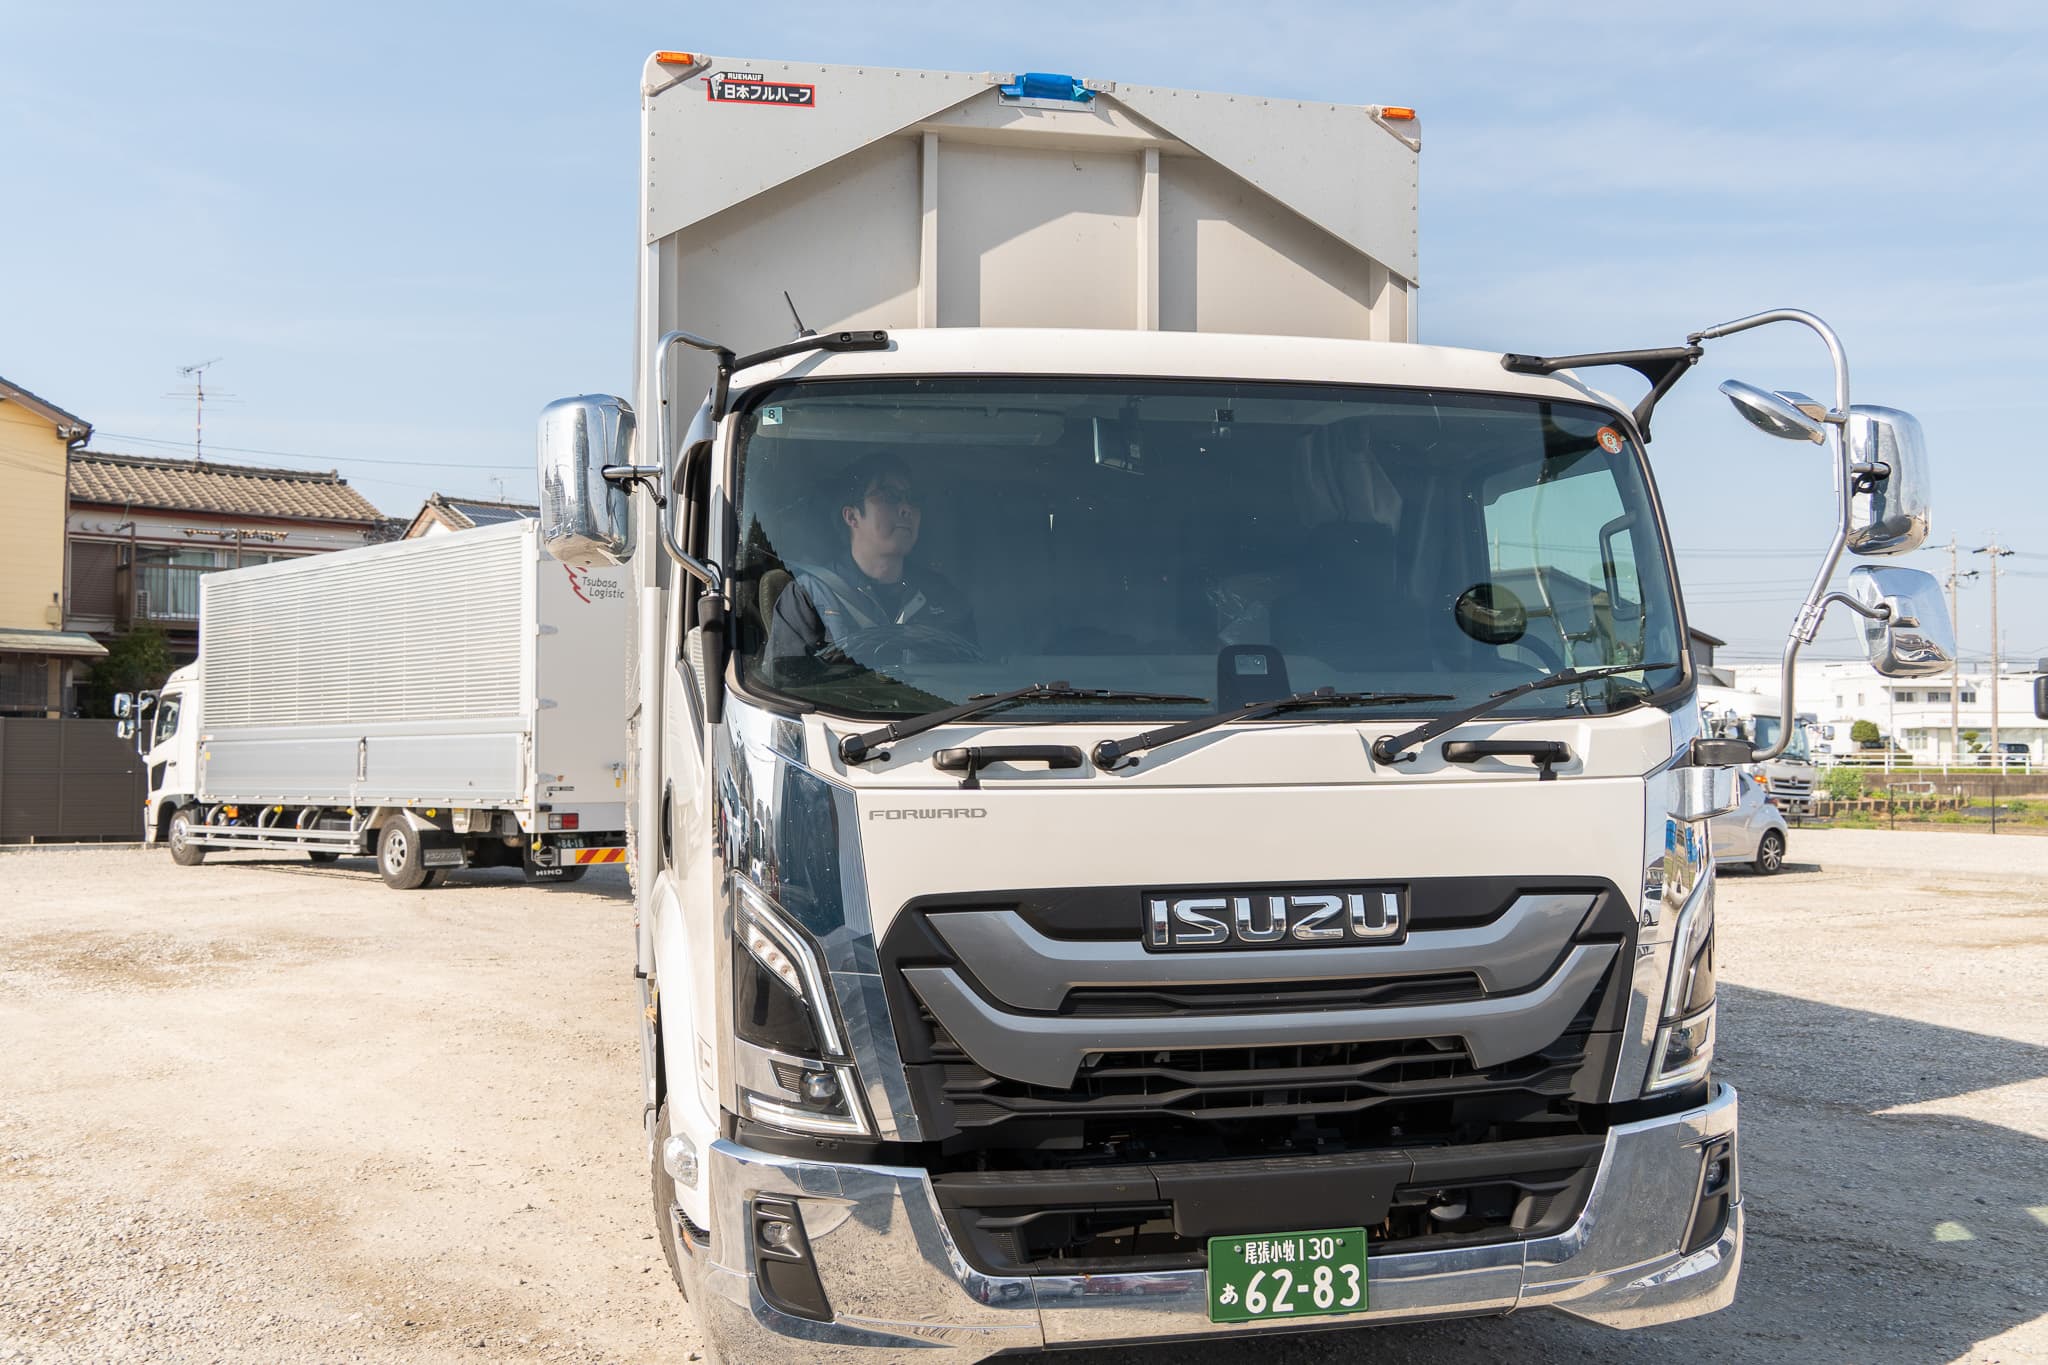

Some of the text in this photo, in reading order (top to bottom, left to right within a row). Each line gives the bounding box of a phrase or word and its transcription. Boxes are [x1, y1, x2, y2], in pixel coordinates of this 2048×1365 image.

[724, 84, 811, 102] 日本フルハーフ
[582, 576, 617, 588] Tsubasa
[869, 808, 987, 820] FORWARD
[535, 868, 563, 876] HINO
[1150, 892, 1399, 945] ISUZU
[1245, 1263, 1361, 1314] 62-83
